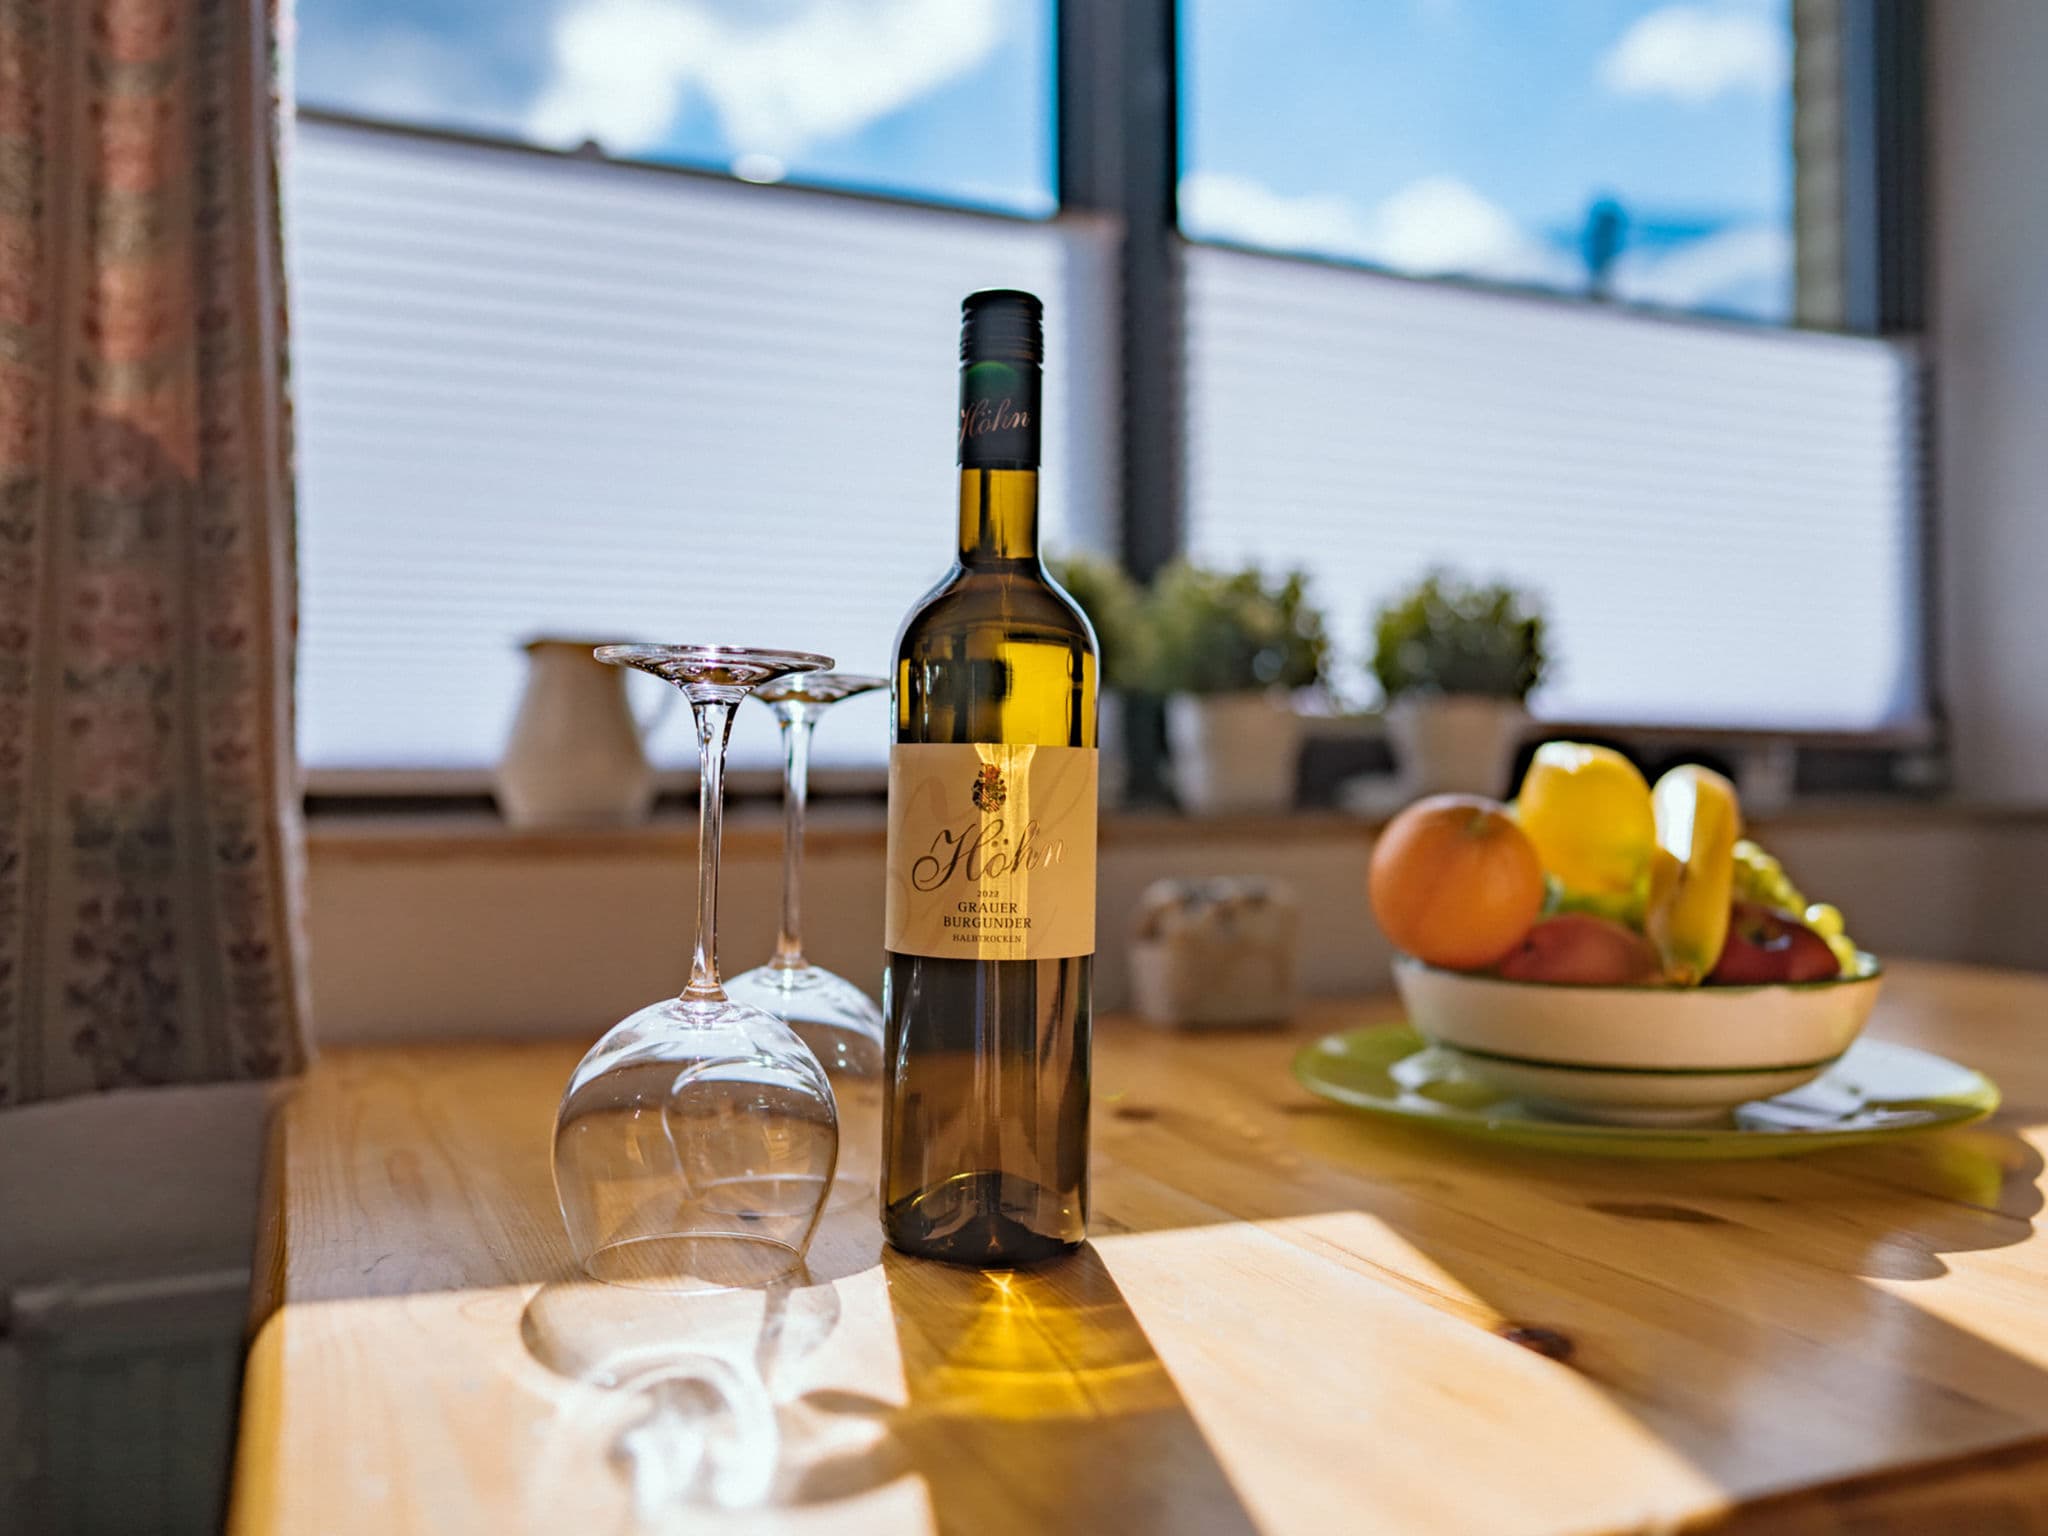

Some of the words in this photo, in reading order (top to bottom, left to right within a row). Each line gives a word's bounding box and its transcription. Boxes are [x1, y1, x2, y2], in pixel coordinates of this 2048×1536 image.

[959, 399, 1031, 444] Höhn
[911, 818, 1064, 892] Höhn
[976, 890, 1000, 898] 2022
[957, 901, 1018, 914] GRAUER
[943, 915, 1032, 928] BURGUNDER
[952, 933, 1022, 943] HALBTROCKEN
